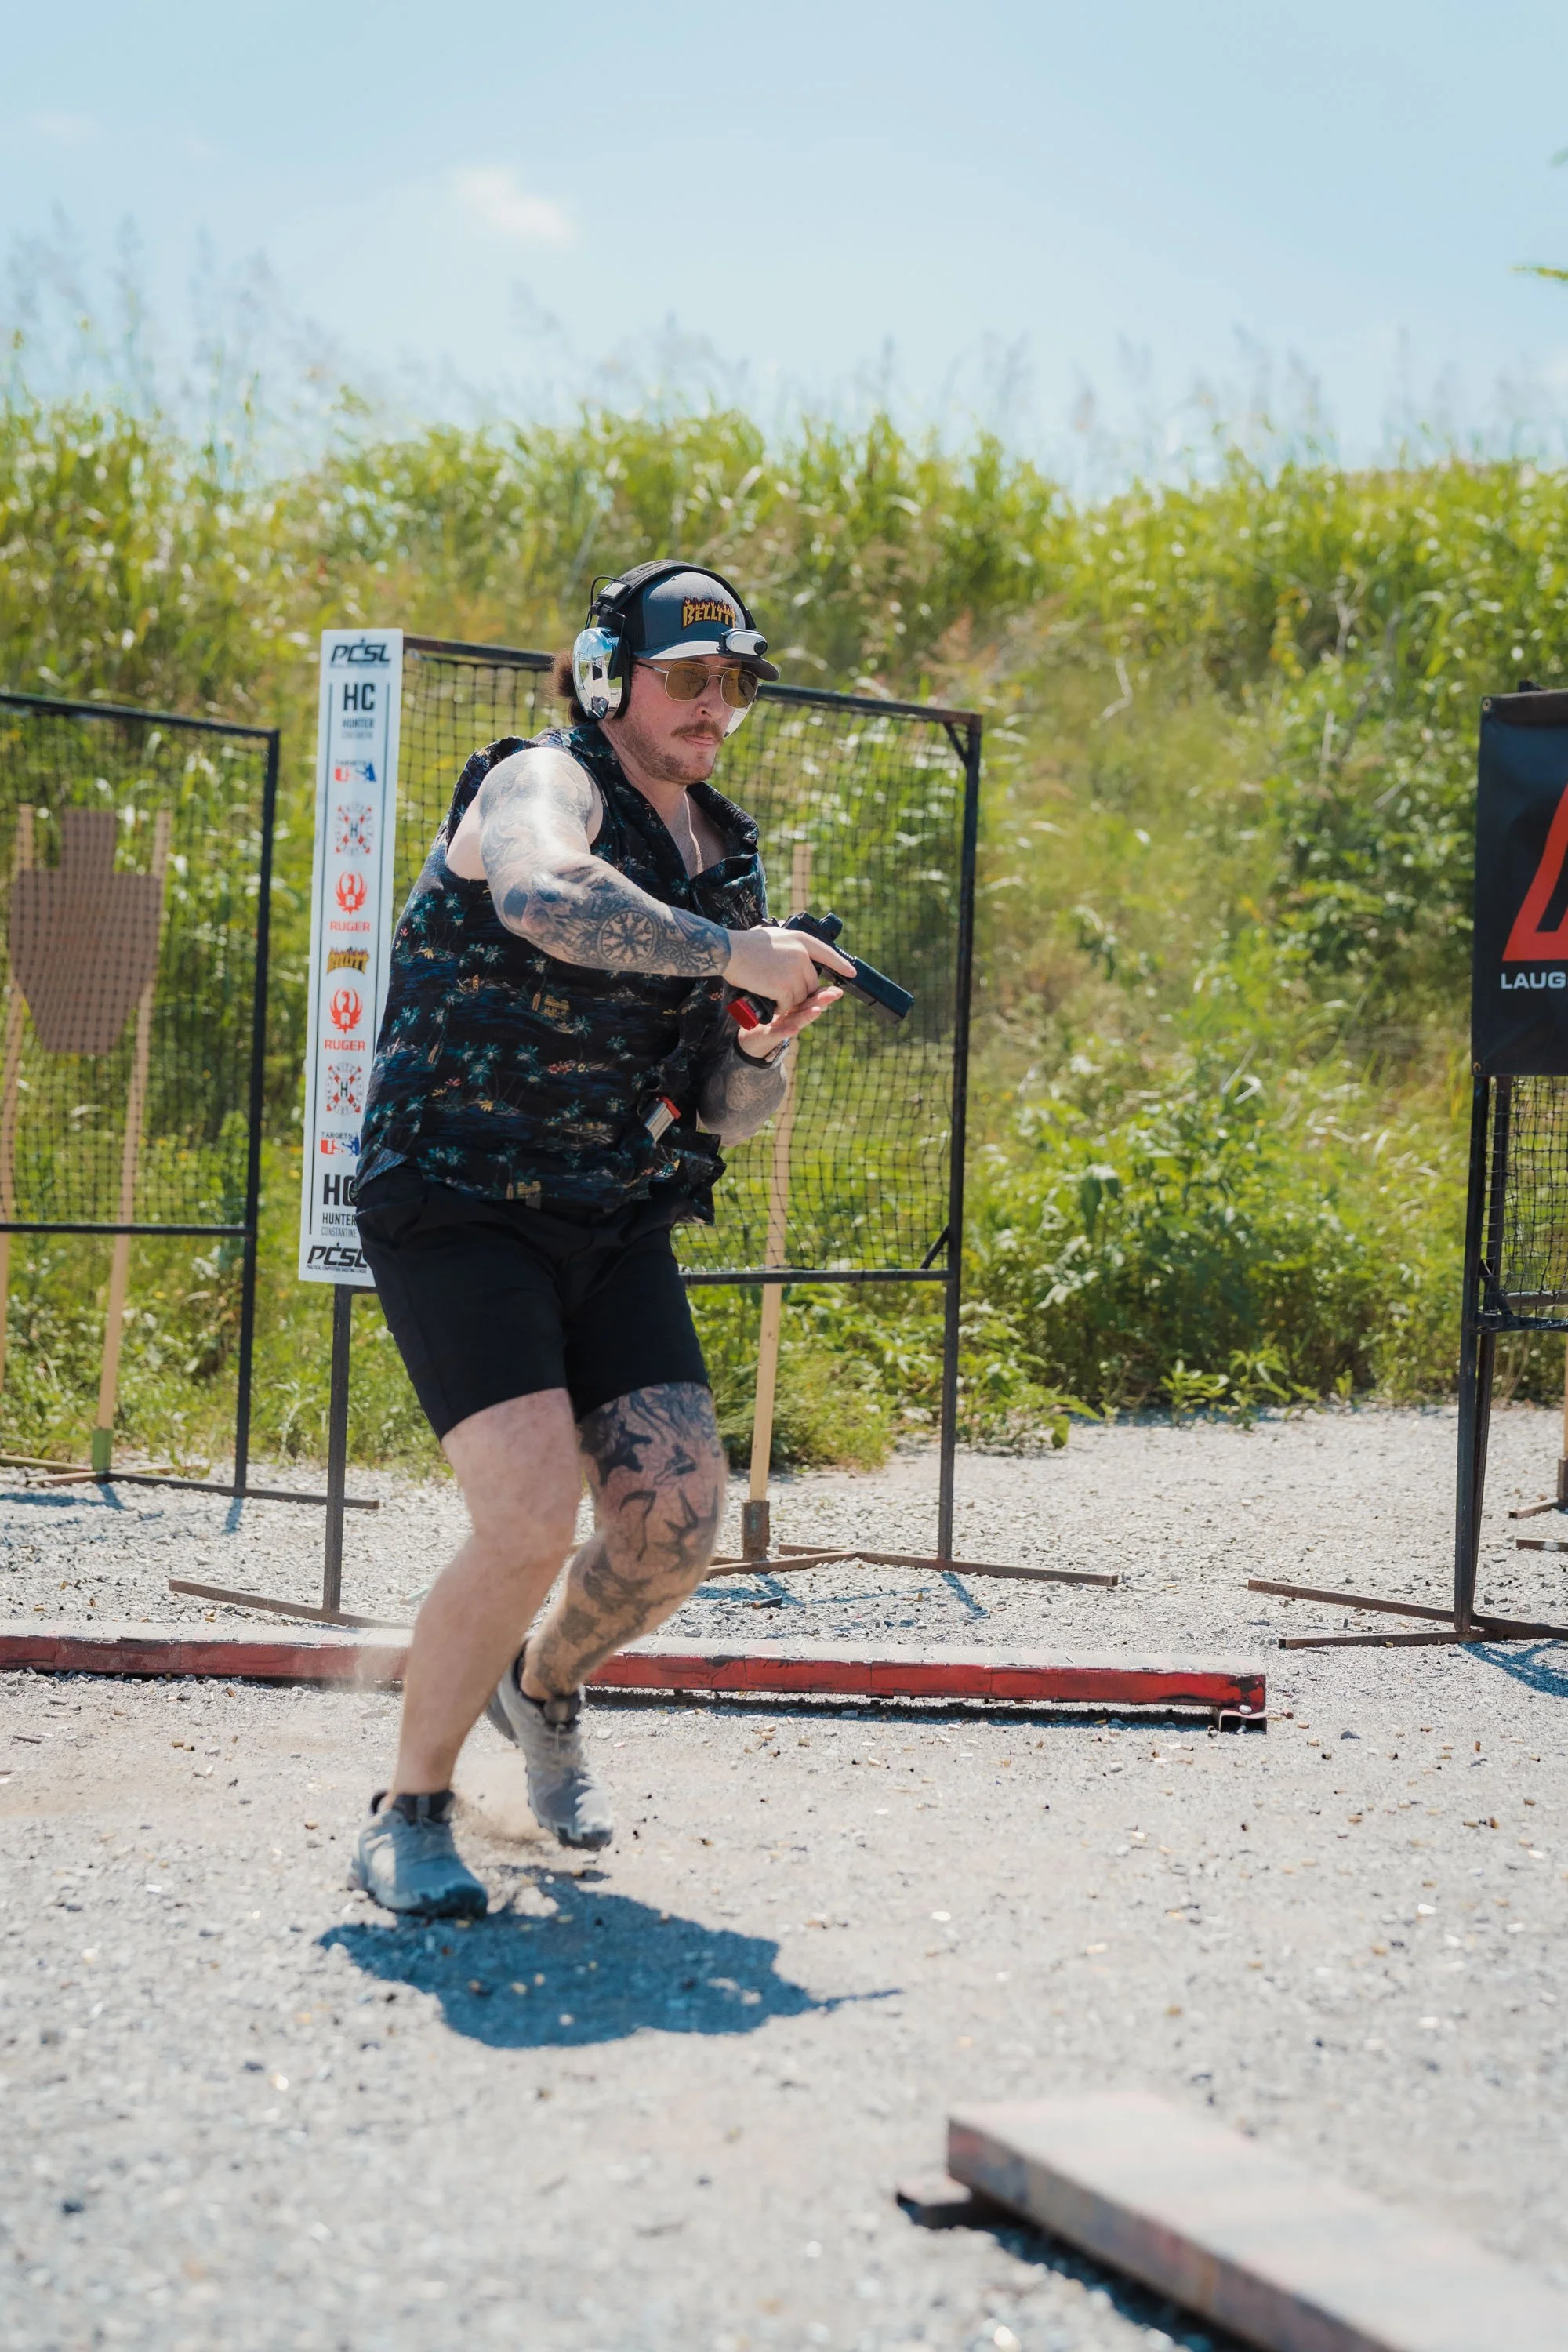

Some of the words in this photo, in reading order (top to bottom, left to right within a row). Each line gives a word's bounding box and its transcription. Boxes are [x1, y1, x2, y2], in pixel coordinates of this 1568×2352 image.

[330, 639, 390, 662] PCSL
[343, 683, 376, 711] HC
[329, 920, 370, 932] RUGER
[1501, 971, 1568, 989] LAUG
[324, 1039, 366, 1051] RUGER
[322, 1211, 357, 1226] HUNTER
[307, 1243, 368, 1268] PCSL
